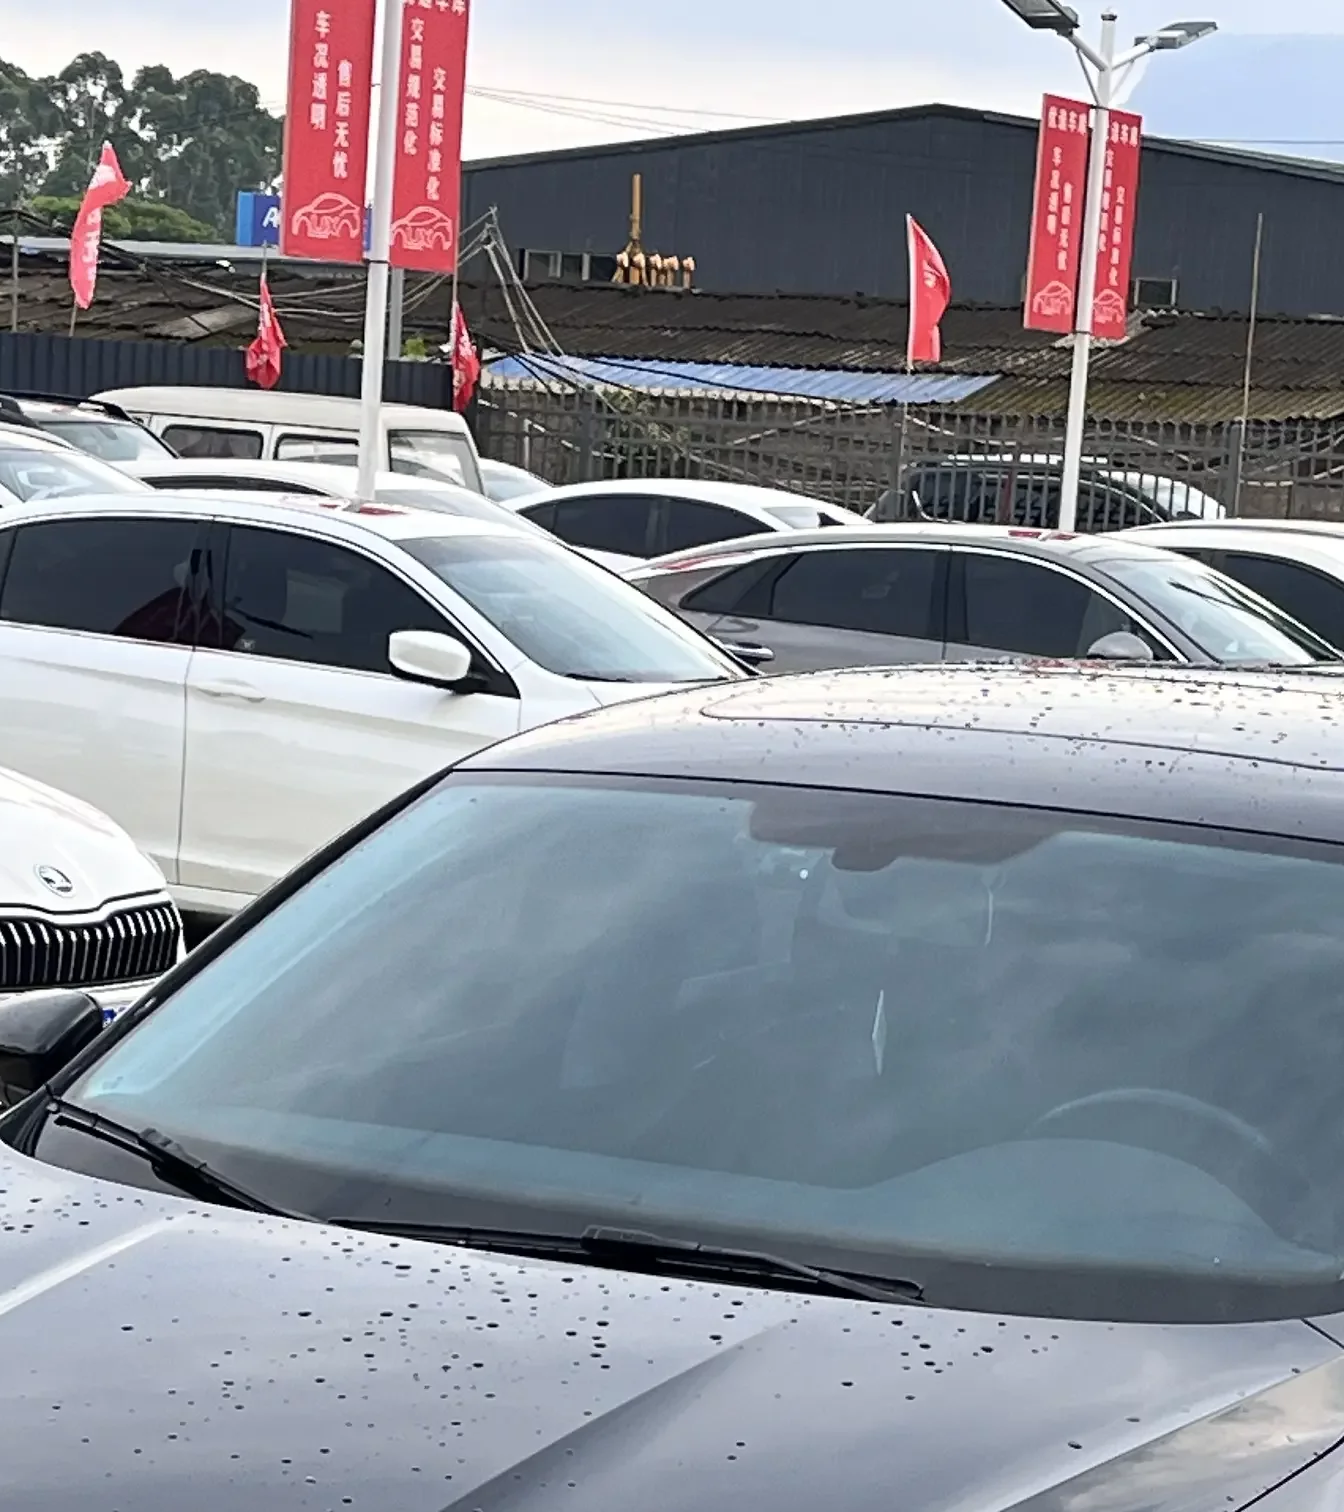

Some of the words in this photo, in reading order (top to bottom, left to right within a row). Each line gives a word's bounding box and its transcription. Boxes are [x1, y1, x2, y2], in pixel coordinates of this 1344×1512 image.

[310, 10, 331, 130] 车况透明
[332, 59, 353, 179] 售后无忧
[404, 17, 425, 156] 交易规范化
[426, 66, 446, 200] 交易标准化
